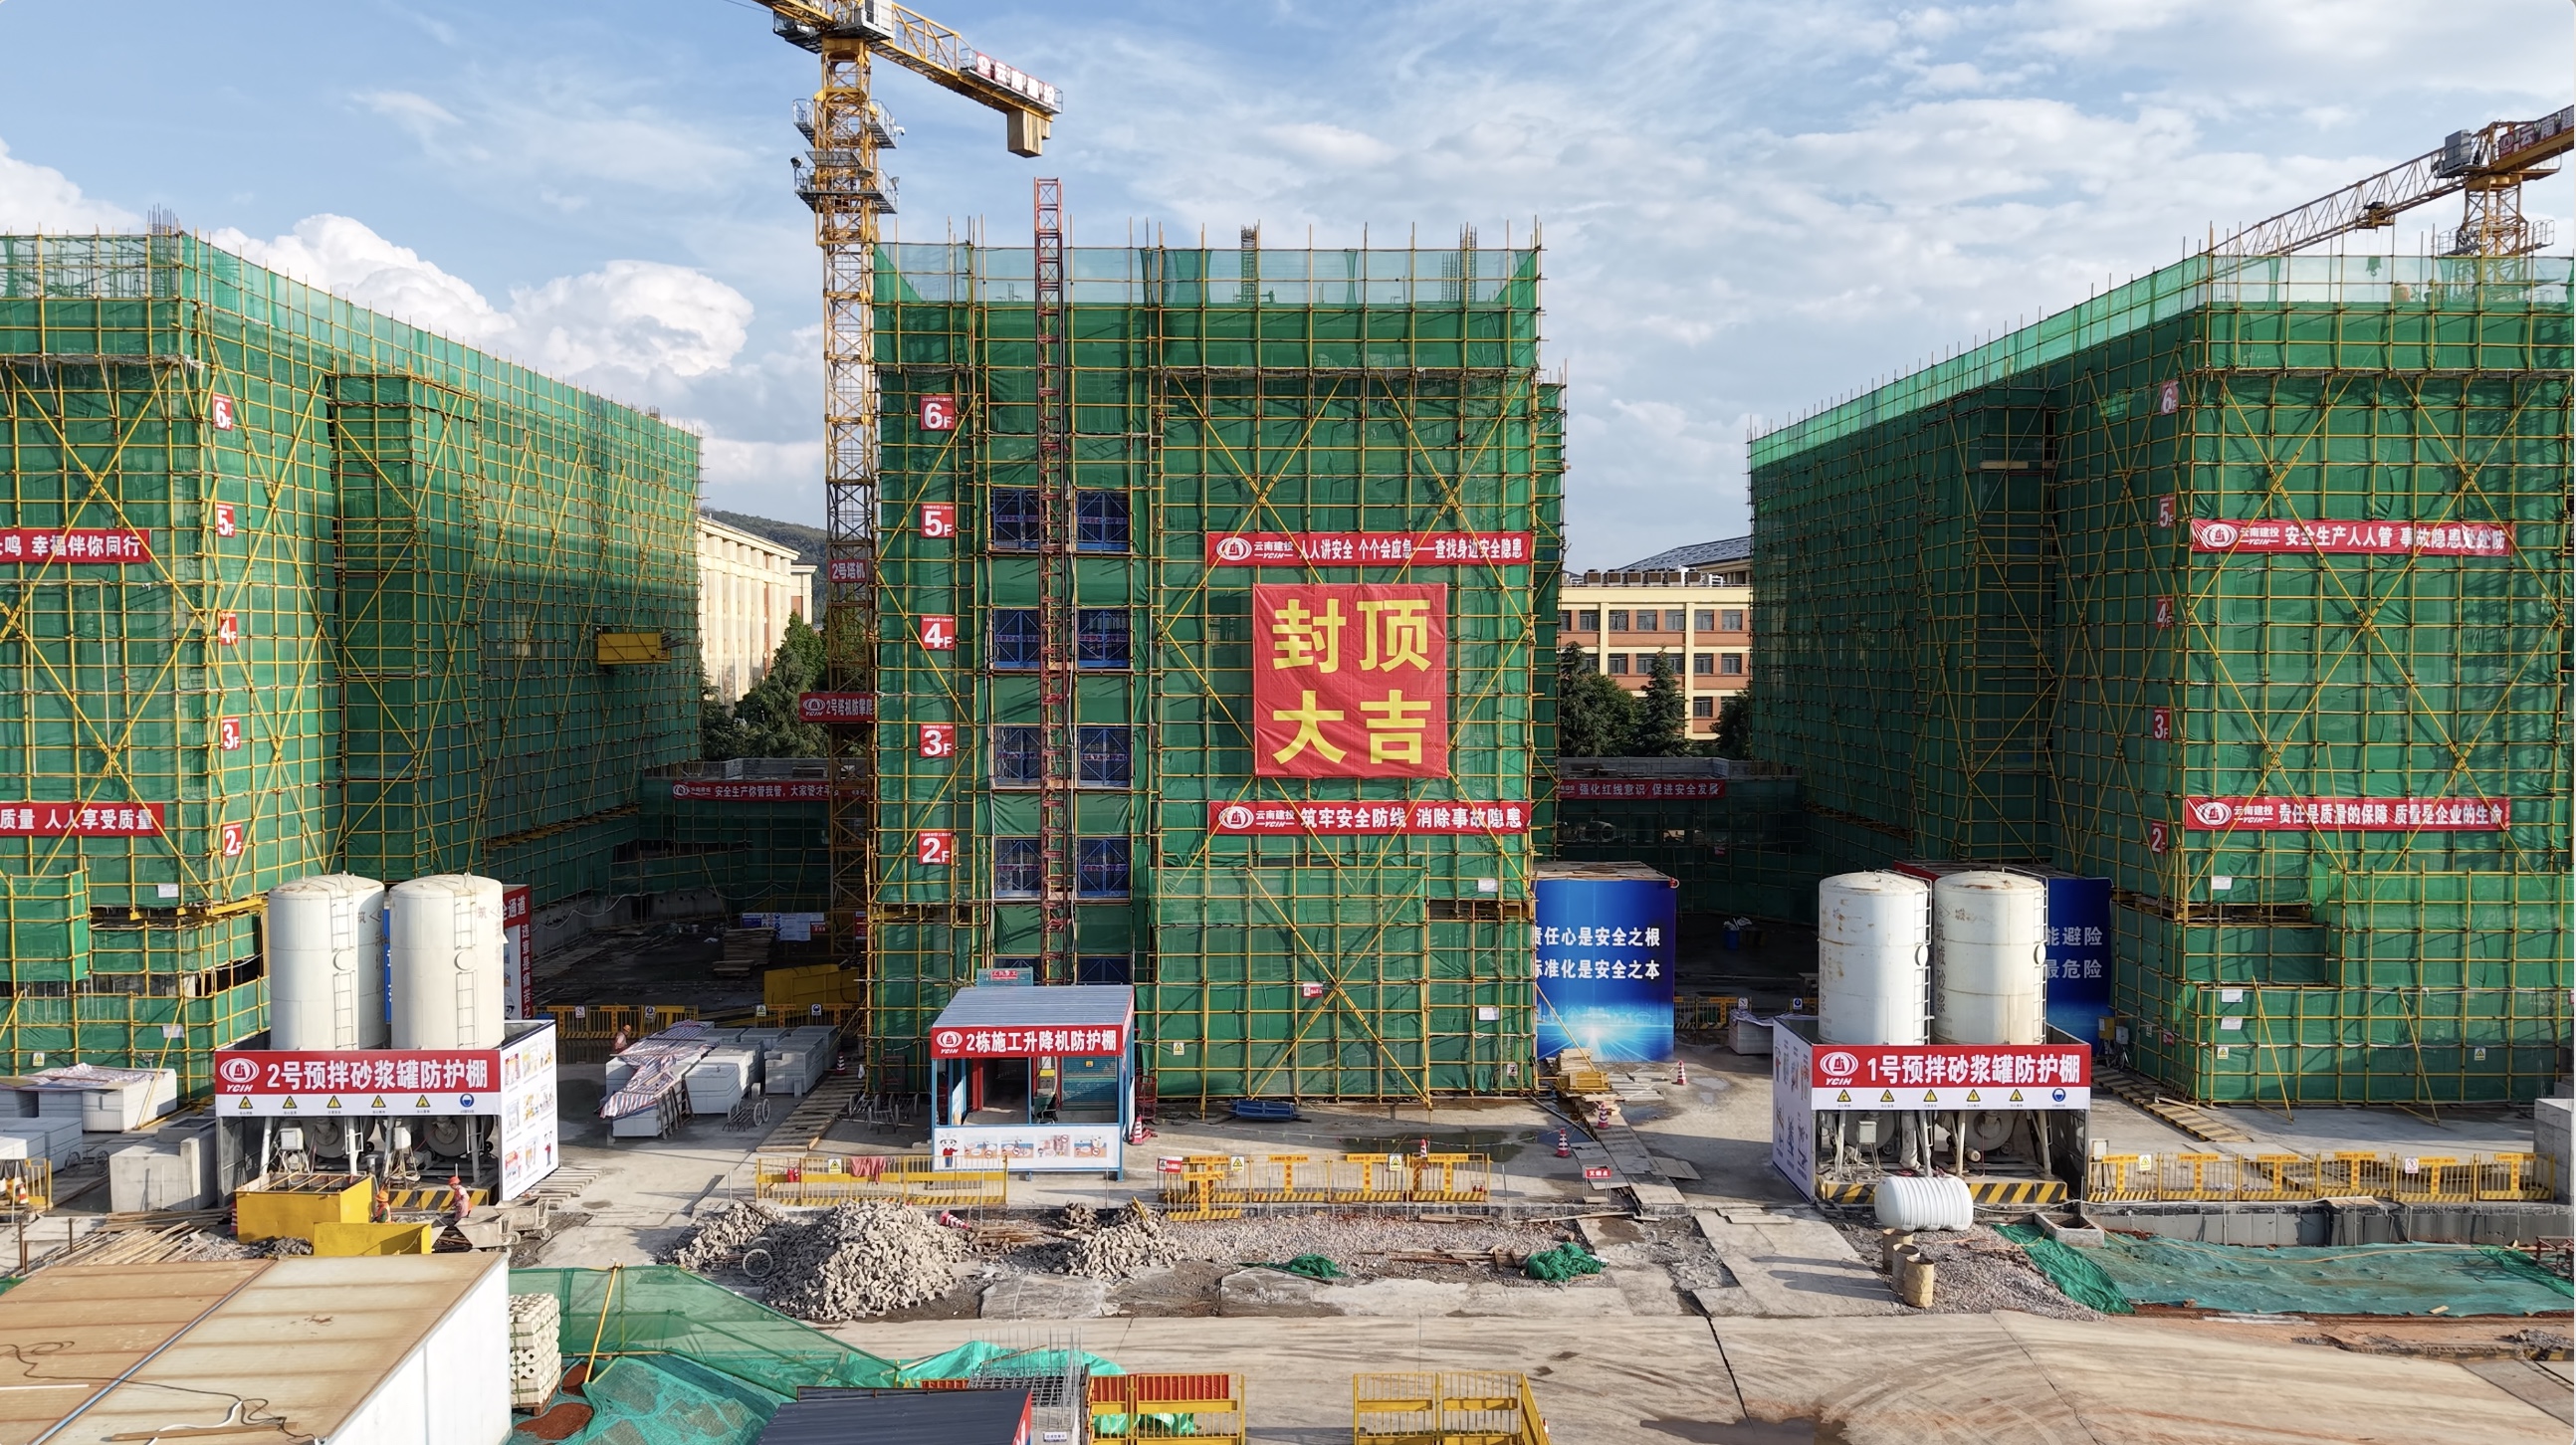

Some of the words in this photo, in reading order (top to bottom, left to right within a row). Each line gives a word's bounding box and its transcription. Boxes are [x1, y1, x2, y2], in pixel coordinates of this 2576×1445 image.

[2163, 388, 2177, 414] 6F
[215, 402, 232, 430] 6F
[925, 402, 953, 429] 6F
[217, 510, 234, 536] 5F
[925, 511, 953, 536] 5F
[0, 535, 22, 556] 鸣
[31, 534, 140, 556] 幸福伴你同行
[1254, 542, 1293, 551] 云南建投
[1298, 538, 1354, 560] 人人讲安全
[2240, 526, 2279, 538] 云南建投
[2284, 525, 2393, 548] 安全生产人人管
[2400, 527, 2505, 550] 事故隐患处处防
[832, 562, 866, 579] 2号塔机
[924, 623, 953, 648] 4F
[1272, 598, 1432, 674] 封顶
[223, 723, 239, 749] 3F
[1272, 689, 1432, 765] 大吉
[2154, 714, 2169, 738] 3F
[924, 729, 952, 755] 3F
[715, 784, 839, 798] 安全生产你管我管，大家管才平
[1579, 783, 1645, 795] 强化红线意识
[1652, 782, 1720, 795] 促进安全发展
[0, 808, 35, 830] 质量
[45, 808, 154, 830] 人人享受质量
[1255, 810, 1295, 821] 云南建投
[1301, 807, 1406, 828] 筑牢安全防线
[1415, 807, 1522, 828] 消除事故隐患
[2234, 806, 2273, 816] 云南建投
[2279, 803, 2388, 825] 责任是质量的保障
[2394, 804, 2503, 826] 质量是企业的生命
[225, 829, 241, 857] 2F
[922, 837, 950, 864] 2F
[2046, 926, 2102, 946] 能避险
[2045, 958, 2102, 979] 最危险
[966, 1029, 1117, 1053] 2栋施工升降机防护棚
[267, 1059, 489, 1092] 2号预拌砂浆罐防护棚
[1825, 1077, 1852, 1086] YCIH
[1866, 1054, 2080, 1086] 1号预拌砂浆罐防护棚
[226, 1084, 254, 1093] YCIH
